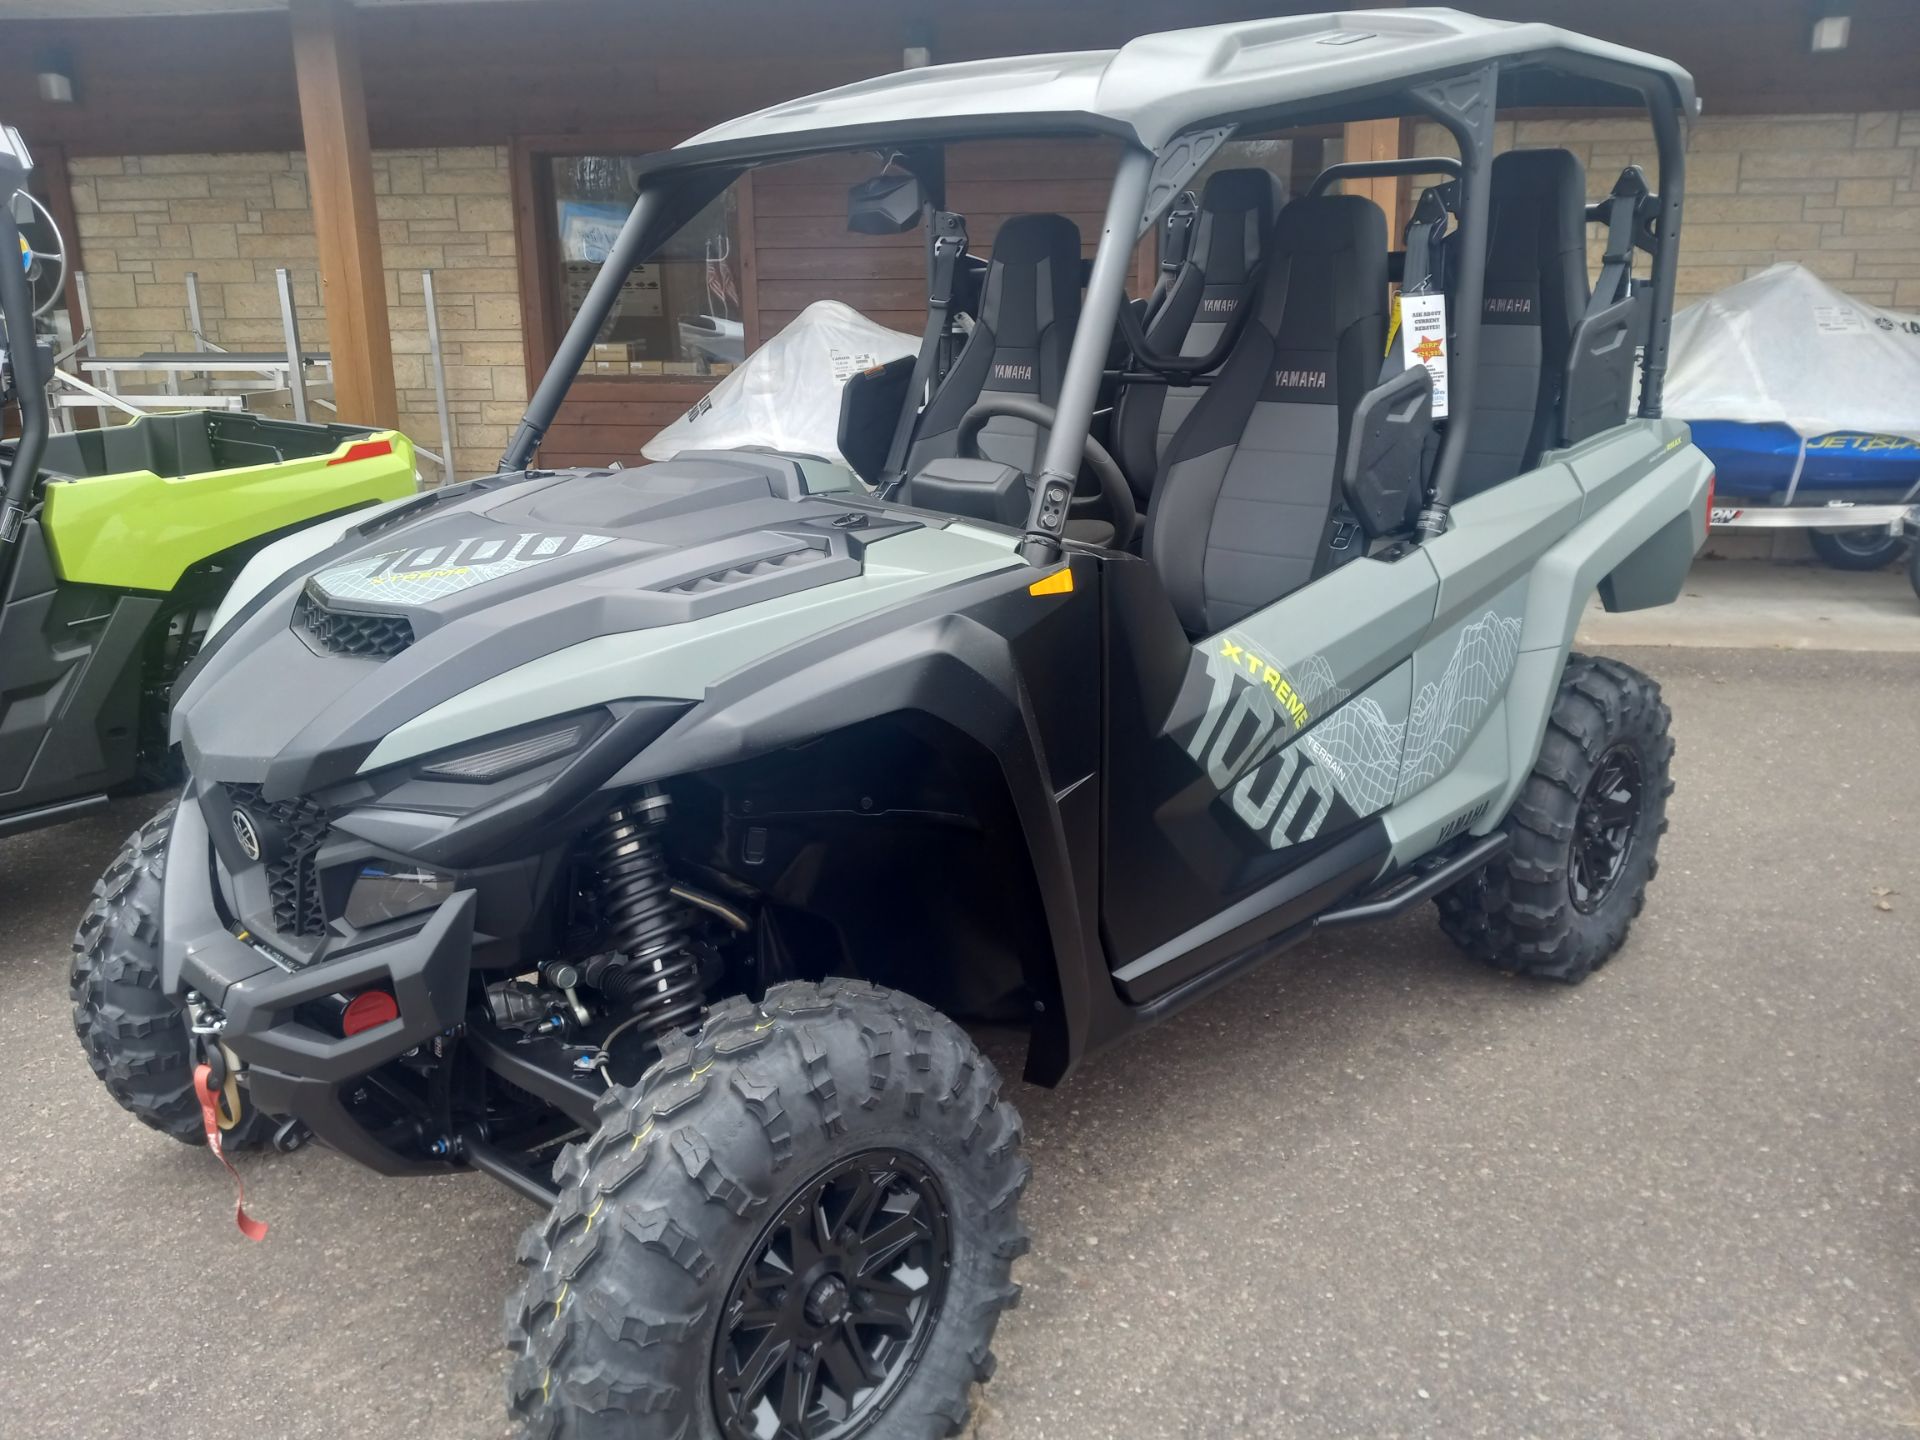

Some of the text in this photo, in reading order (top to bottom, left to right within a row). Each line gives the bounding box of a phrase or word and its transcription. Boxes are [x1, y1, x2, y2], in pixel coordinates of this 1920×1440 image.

[994, 364, 1032, 380] YAMAHA
[1275, 370, 1326, 388] YAMAHA
[366, 533, 583, 578] 1000
[1220, 638, 1311, 730] XTREME
[1187, 652, 1335, 850] 1000
[1304, 733, 1346, 782] TERRAIN
[1436, 799, 1490, 845] YAMAHA
